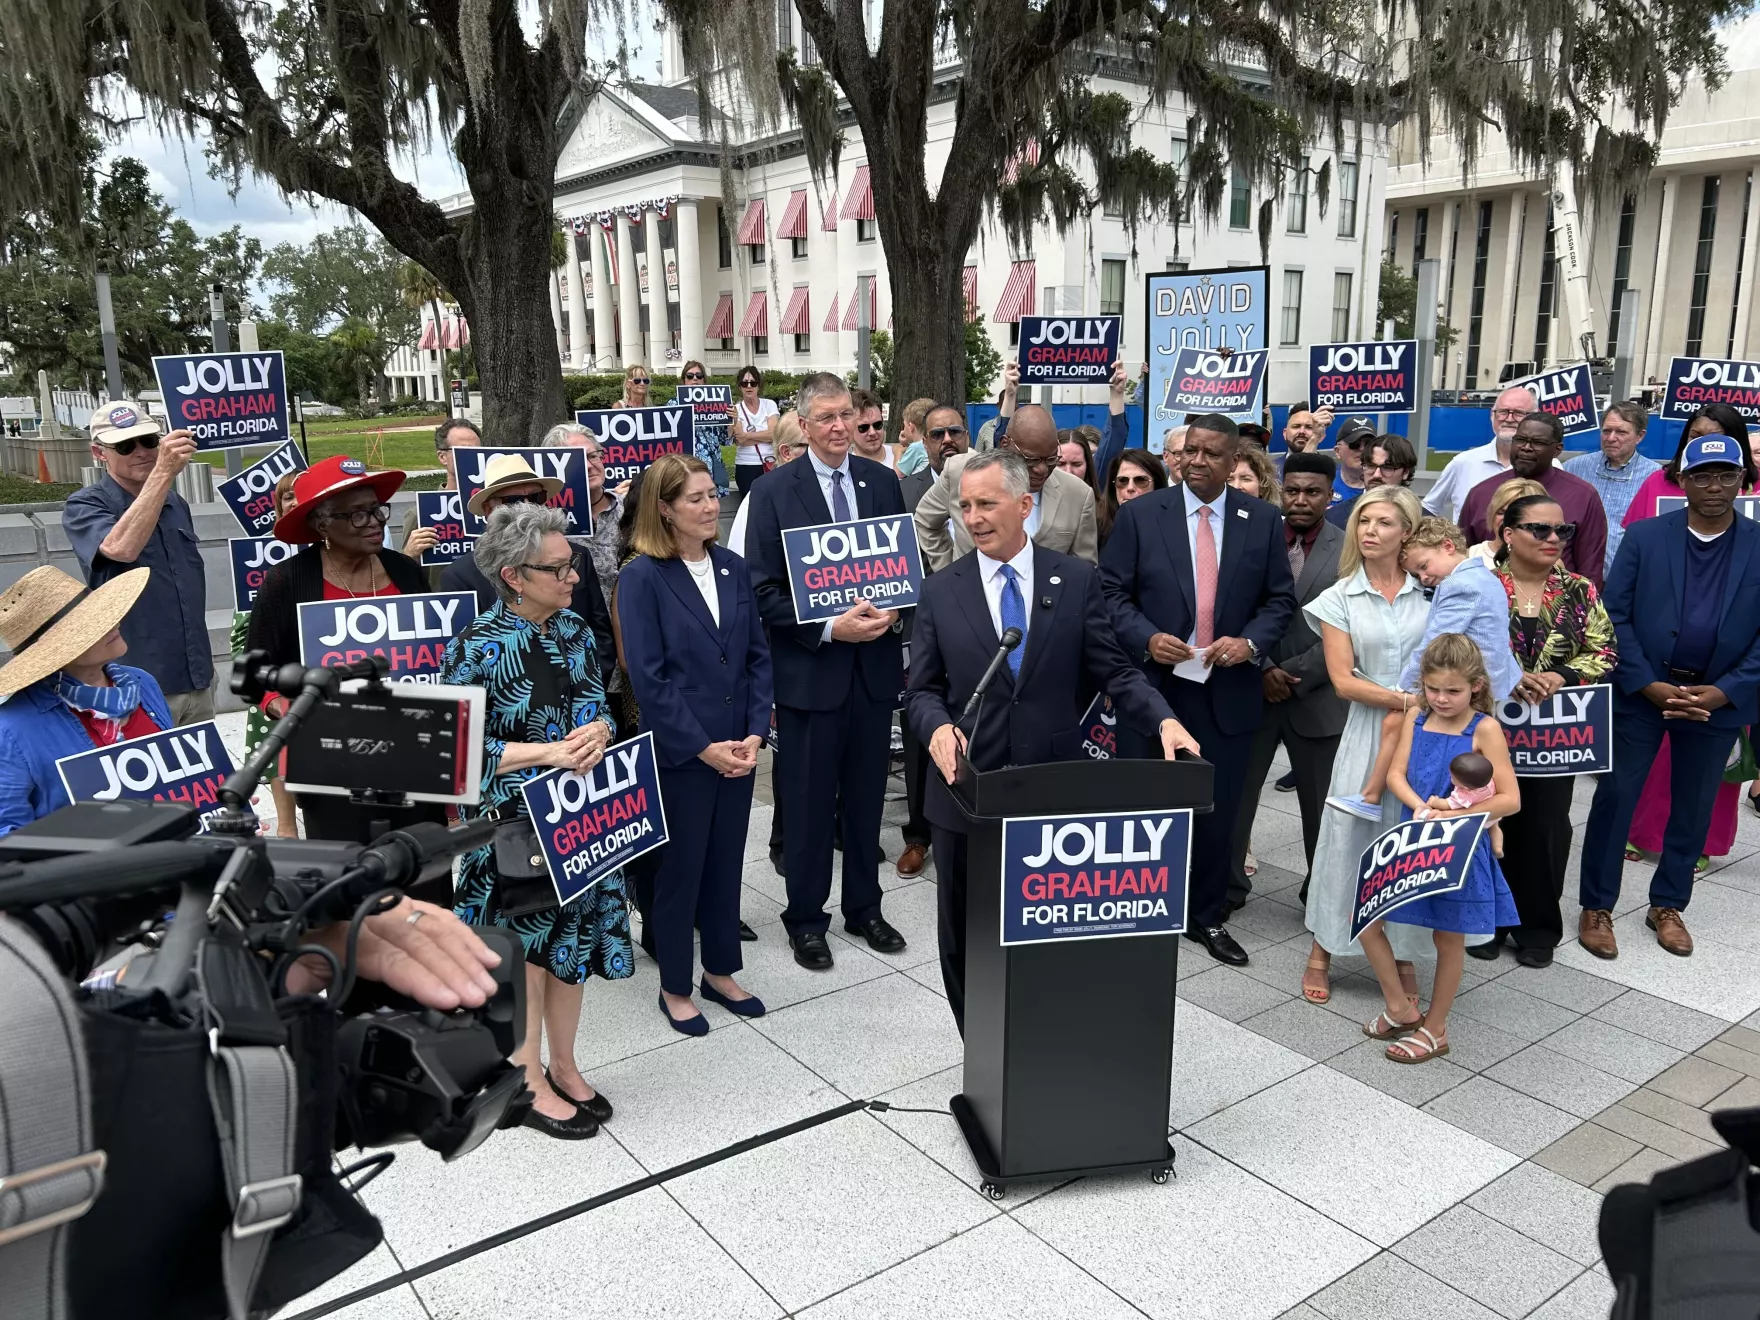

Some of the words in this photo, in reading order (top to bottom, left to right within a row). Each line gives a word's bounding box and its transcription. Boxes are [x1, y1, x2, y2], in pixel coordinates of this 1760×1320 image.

[1156, 283, 1251, 317] DAVID
[1029, 320, 1112, 345] JOLLY
[1028, 347, 1109, 362] GRAHAM
[1184, 353, 1261, 378] JOLLY
[1318, 345, 1406, 373] JOLLY
[176, 357, 272, 395] JOLLY
[1027, 365, 1052, 376] FOR
[1055, 365, 1107, 376] FLORIDA
[1317, 373, 1404, 391] GRAHAM
[684, 387, 726, 402] JOLLY
[1175, 393, 1200, 405] FOR
[1201, 395, 1247, 406] FLORIDA
[1180, 377, 1252, 394] GRAHAM
[1317, 394, 1343, 405] FOR
[1346, 392, 1404, 404] FLORIDA
[1676, 385, 1760, 405] GRAHAM
[112, 408, 130, 419] JOLLY
[181, 393, 276, 421] GRAHAM
[694, 403, 728, 413] RAHAM
[700, 413, 729, 421] FLORIDA
[1543, 395, 1584, 415] HAM
[1558, 412, 1587, 426] RIDA
[1673, 401, 1701, 413] FOR
[221, 417, 278, 436] FLORIDA
[595, 410, 683, 443] JOLLY
[237, 446, 297, 503] JOLLY
[604, 466, 625, 480] OR
[433, 542, 460, 554] FOR
[801, 521, 901, 565] JOLLY
[804, 556, 909, 590] GRAHAM
[808, 590, 843, 608] FOR
[844, 580, 914, 602] FLORIDA
[319, 599, 460, 646] JOLLY
[1492, 691, 1595, 726] OLLY
[93, 730, 214, 800] JOLLY
[1515, 748, 1596, 765] FLORIDA
[545, 744, 641, 824] JOLLY
[553, 787, 648, 855] GRAHAM
[562, 851, 592, 881] FOR
[589, 817, 654, 859] FLORIDA
[1022, 818, 1173, 868] JOLLY
[1364, 818, 1470, 880] JOLLY
[1022, 866, 1169, 901] GRAHAM
[1360, 846, 1456, 903] GRAHAM
[1357, 894, 1378, 924] FOR
[1379, 866, 1448, 901] FLORIDA
[1022, 905, 1068, 926] FOR
[1074, 898, 1168, 922] FLORIDA
